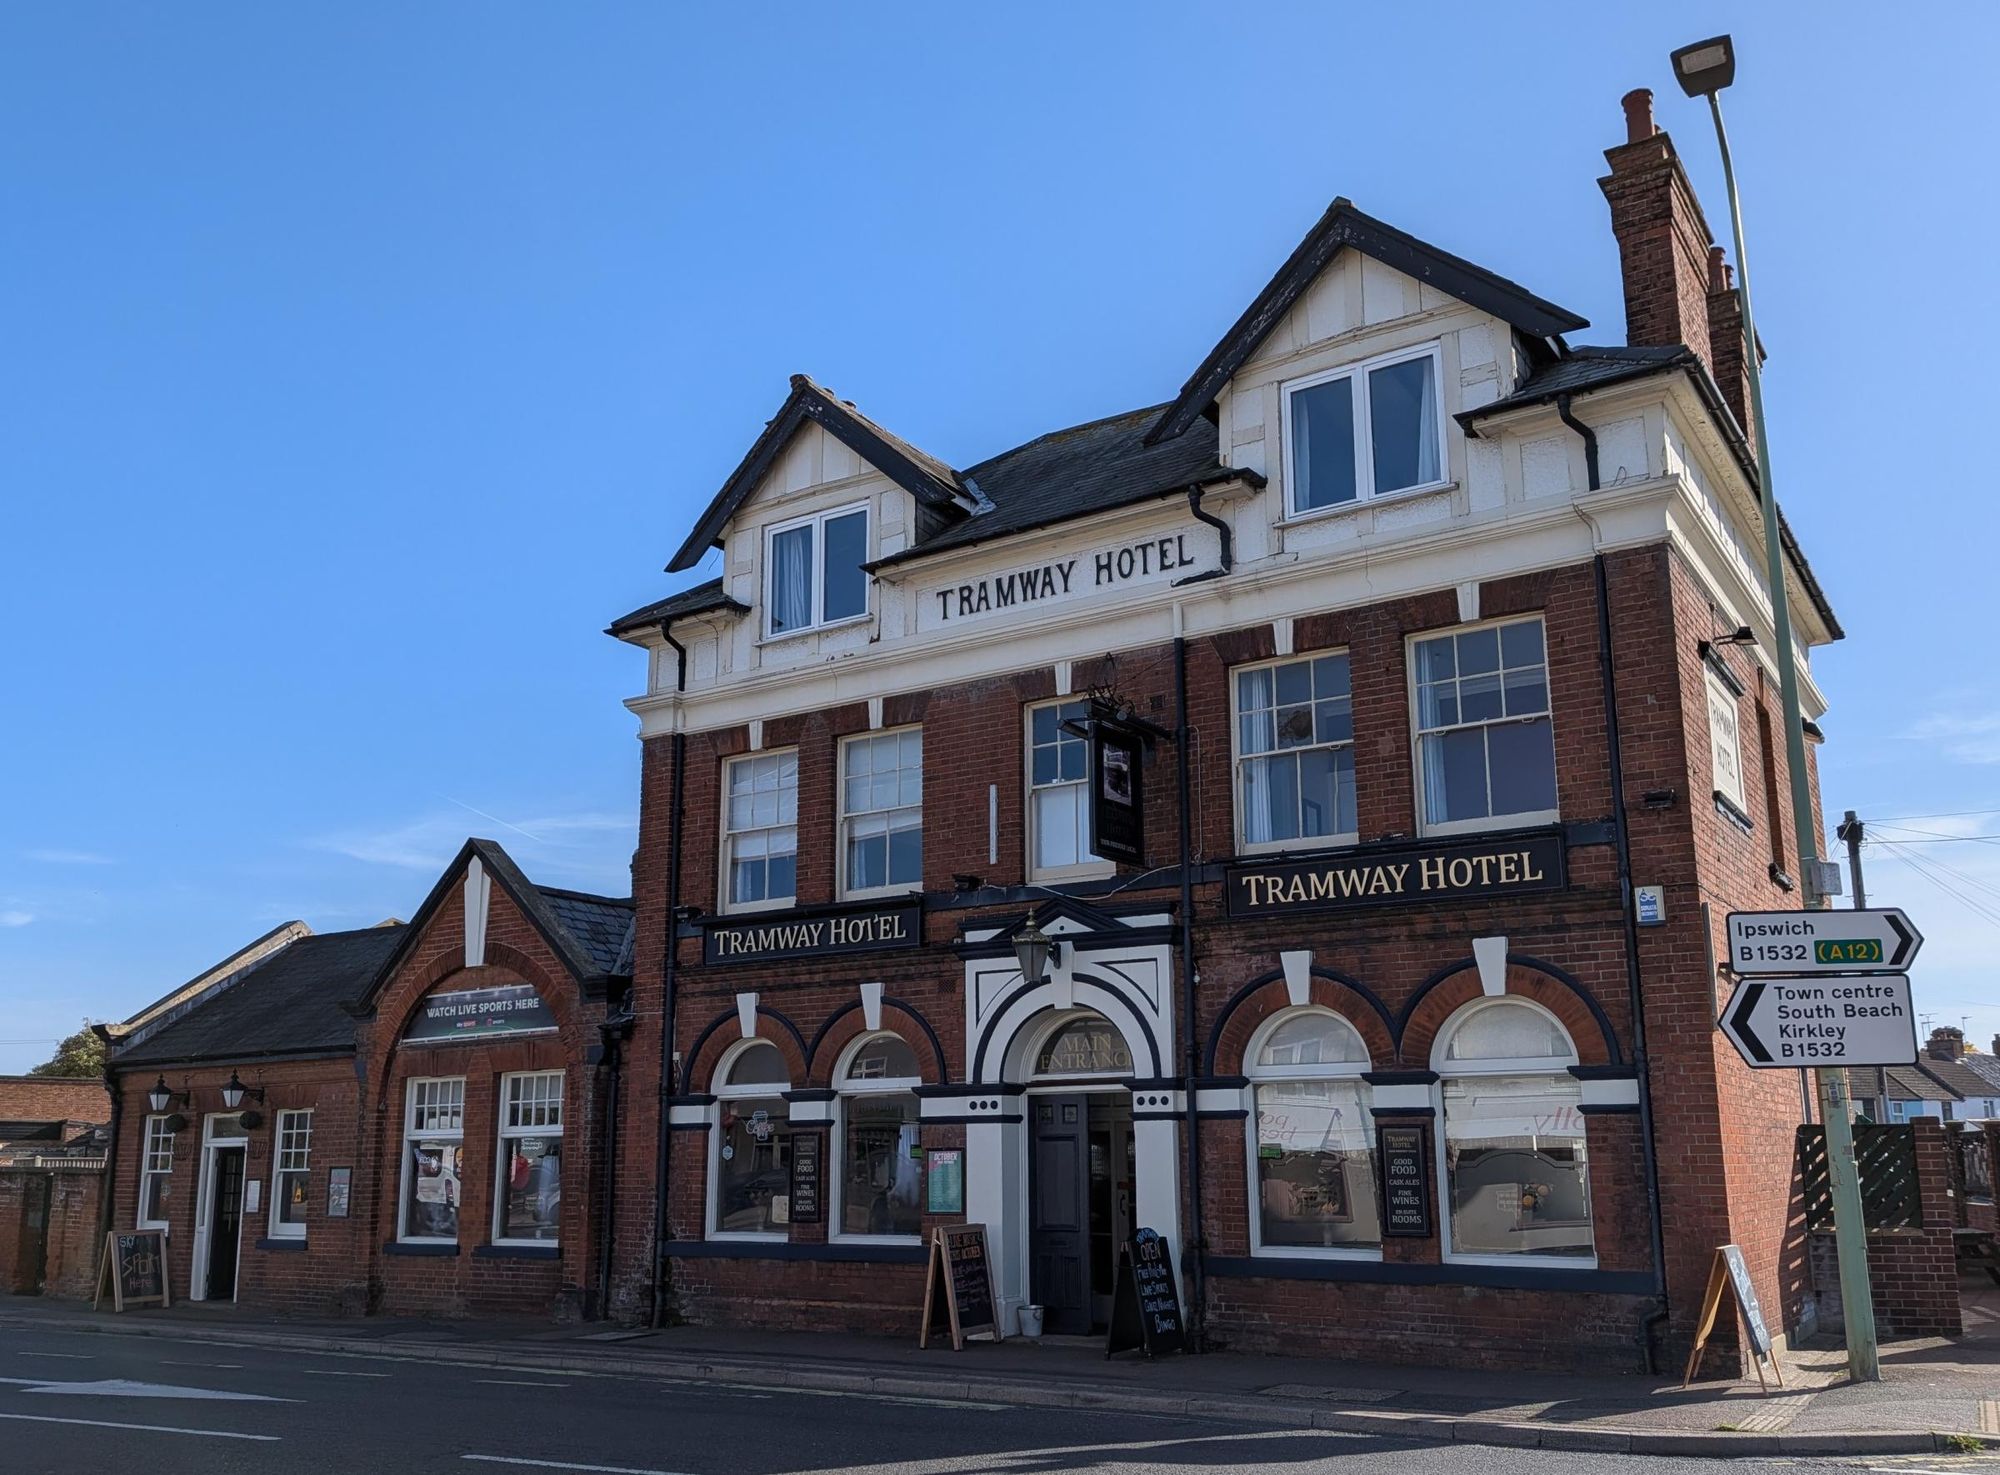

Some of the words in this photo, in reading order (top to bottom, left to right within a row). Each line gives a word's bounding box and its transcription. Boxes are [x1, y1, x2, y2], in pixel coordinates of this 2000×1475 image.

[936, 560, 1076, 620] TRAMWAY
[1095, 534, 1195, 586] HOTEL
[1242, 864, 1409, 907] TRAMWAY
[1418, 851, 1543, 891] HOTEL
[714, 922, 824, 956] TRAMWAY
[830, 913, 907, 945] HOTEL
[1737, 919, 1815, 939] Ipswich
[1773, 986, 1825, 1001] Town
[1831, 984, 1895, 1000] centre
[427, 1005, 456, 1018] WATCH
[458, 1003, 477, 1015] LIVE
[478, 1000, 513, 1014] SPORTS
[515, 997, 540, 1010] HERE
[1777, 1004, 1836, 1019] South
[1843, 1002, 1904, 1018] Beach
[1779, 1023, 1847, 1041] Kirkley
[1064, 1033, 1112, 1052] MAIN
[1388, 1136, 1417, 1144] TRAMWAY
[934, 1152, 958, 1161] OCTOBER
[1393, 1158, 1413, 1166] GOOD
[797, 1165, 814, 1173] FOOD
[1391, 1165, 1417, 1175] FOOD
[1392, 1197, 1420, 1205] WINES
[1392, 1215, 1422, 1224] ROOMS
[119, 1235, 136, 1249] SKY
